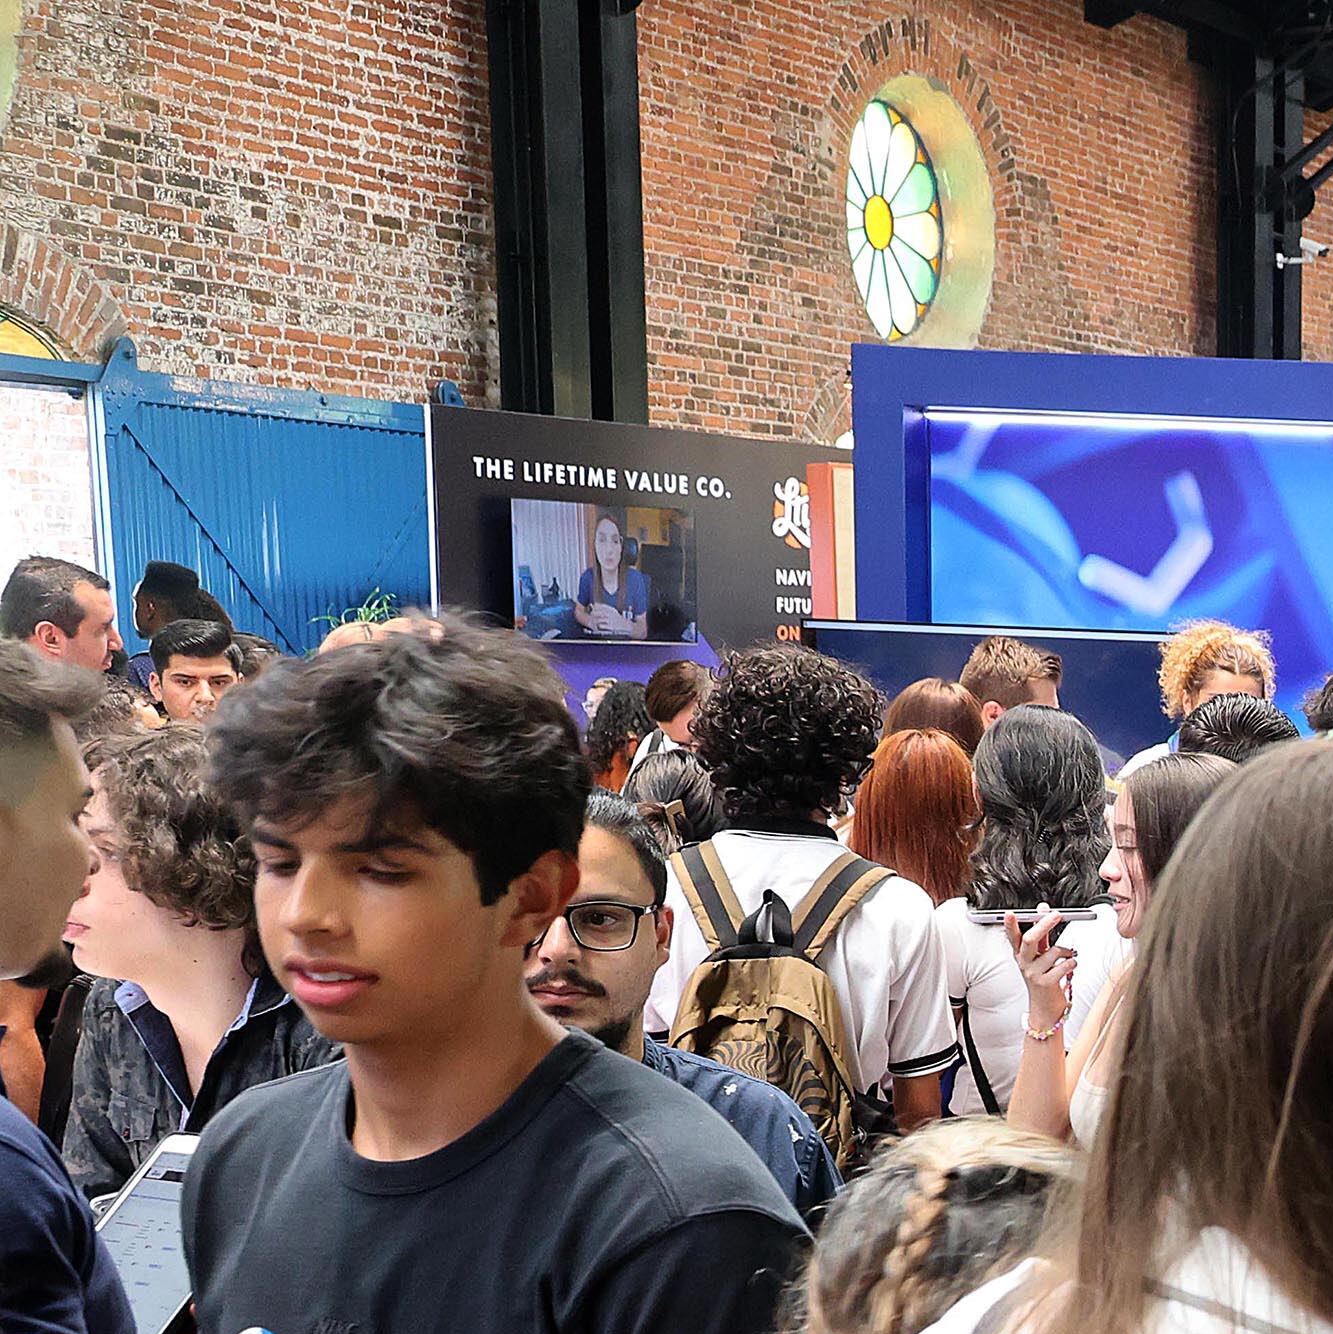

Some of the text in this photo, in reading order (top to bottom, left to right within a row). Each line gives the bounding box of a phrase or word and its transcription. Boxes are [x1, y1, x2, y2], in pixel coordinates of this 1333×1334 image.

[472, 456, 732, 499] THE LIFETIME VALUE CO.
[776, 596, 812, 614] FUTU
